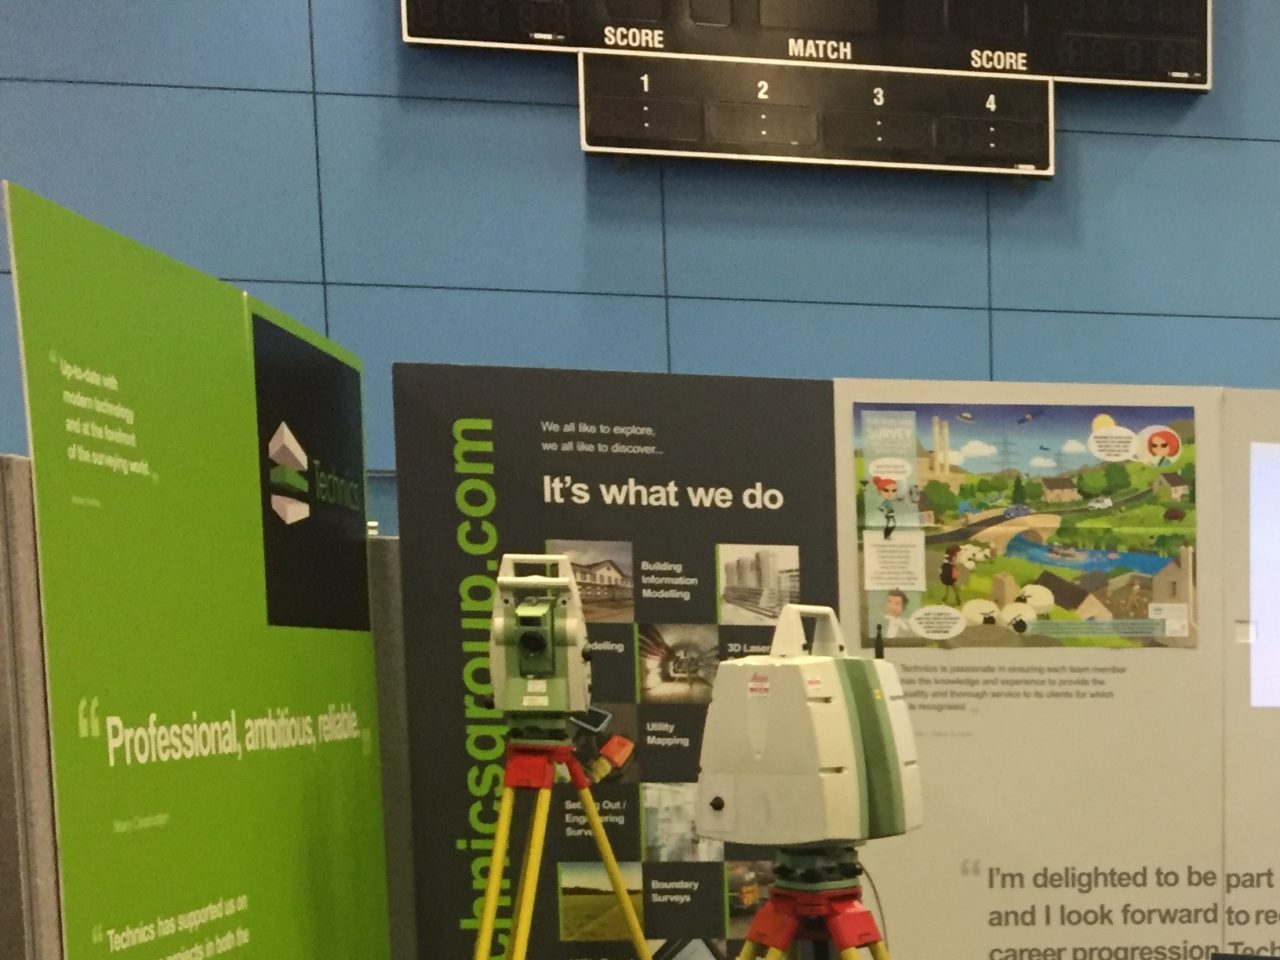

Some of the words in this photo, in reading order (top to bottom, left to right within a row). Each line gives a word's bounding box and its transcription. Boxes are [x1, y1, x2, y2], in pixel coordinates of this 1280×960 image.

[604, 26, 664, 49] SCORE
[788, 37, 852, 60] MATCH
[970, 49, 1028, 71] SCORE
[640, 73, 650, 93] 1
[757, 80, 769, 99] 2
[873, 87, 885, 106] 3
[985, 94, 997, 112] 4
[541, 421, 560, 432] We
[563, 421, 576, 433] all
[578, 422, 597, 434] like
[600, 424, 610, 434] to
[541, 441, 558, 451] we
[561, 441, 574, 452] all
[576, 441, 595, 452] like
[598, 442, 608, 453] to
[543, 475, 591, 504] It's
[600, 478, 680, 507] what
[686, 485, 734, 508] we
[742, 482, 784, 510] do
[641, 561, 683, 574] Building
[642, 575, 698, 587] Information
[642, 589, 691, 601] Modelling
[728, 643, 742, 653] 3D
[646, 722, 675, 734] Utility
[106, 709, 243, 768] Professional,
[646, 736, 690, 748] Mapping
[651, 880, 699, 891] Boundary
[988, 867, 1024, 889] I'm
[1032, 866, 1147, 894] delighted
[1155, 866, 1180, 888] to
[1187, 865, 1217, 888] be
[1225, 866, 1274, 894] part
[652, 893, 692, 904] Surveys
[988, 904, 1036, 927] and
[1045, 904, 1051, 926] I
[1060, 903, 1114, 926] look
[1121, 903, 1218, 926] forward
[1225, 906, 1250, 926] to
[107, 921, 156, 952] Technics
[157, 916, 176, 937] has
[177, 898, 224, 932] supported
